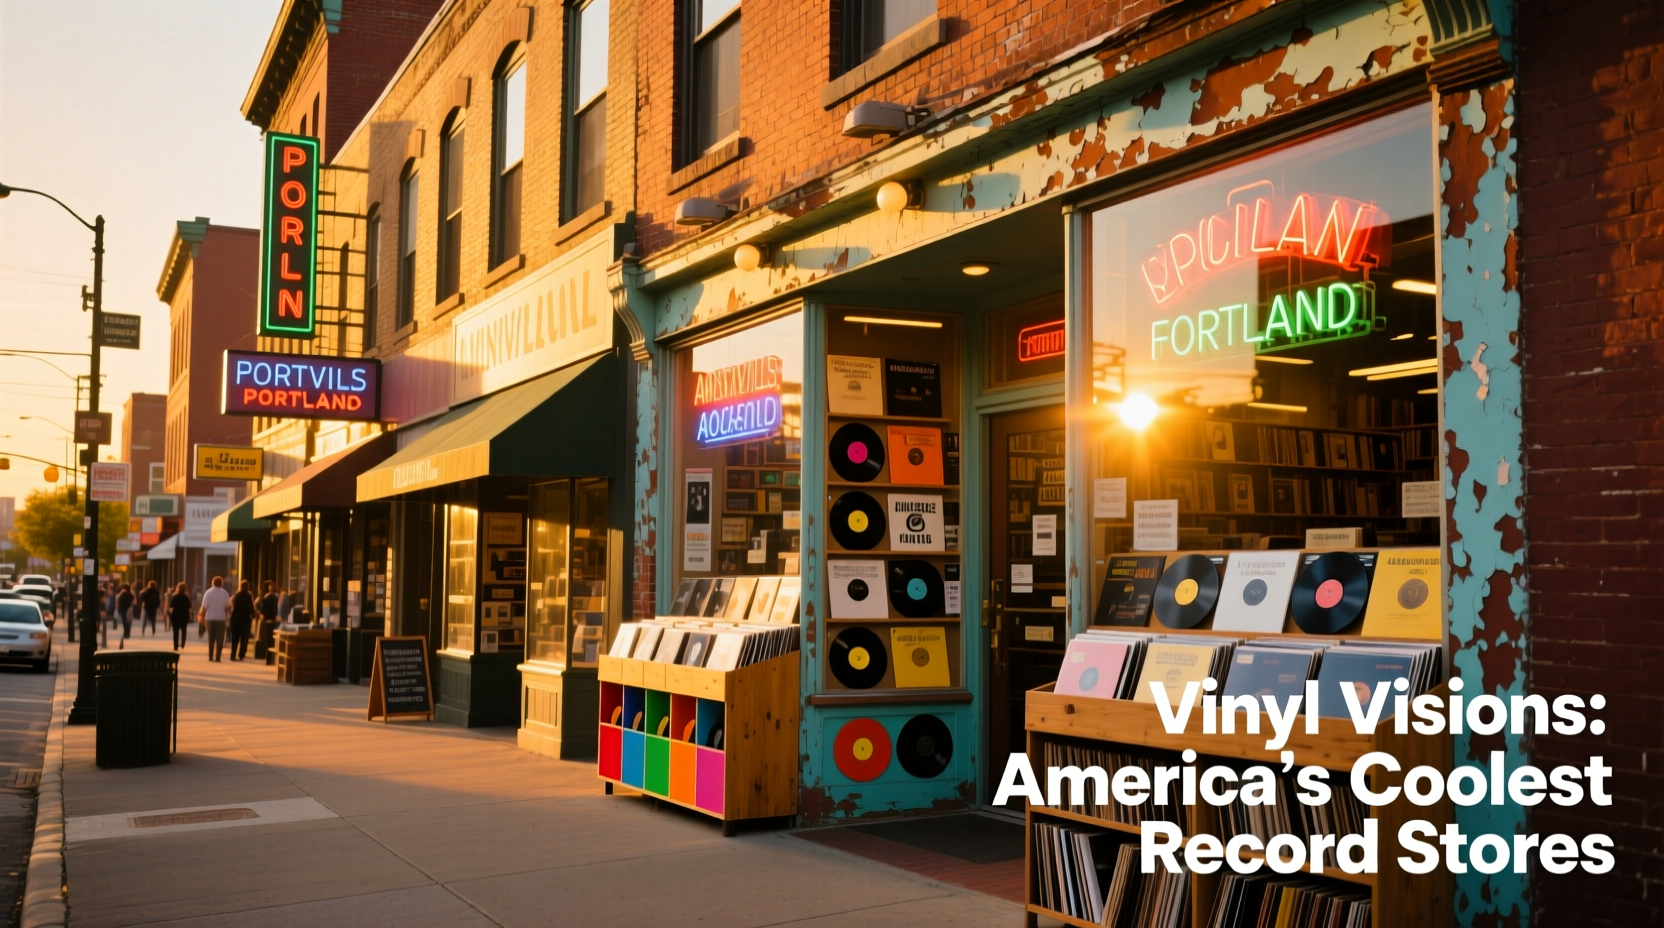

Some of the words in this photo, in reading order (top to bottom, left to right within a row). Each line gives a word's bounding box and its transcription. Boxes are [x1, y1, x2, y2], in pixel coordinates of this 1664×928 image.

[278, 145, 308, 319] PORLN
[236, 359, 367, 392] PORTVILS
[243, 387, 363, 411] PORTLAND
